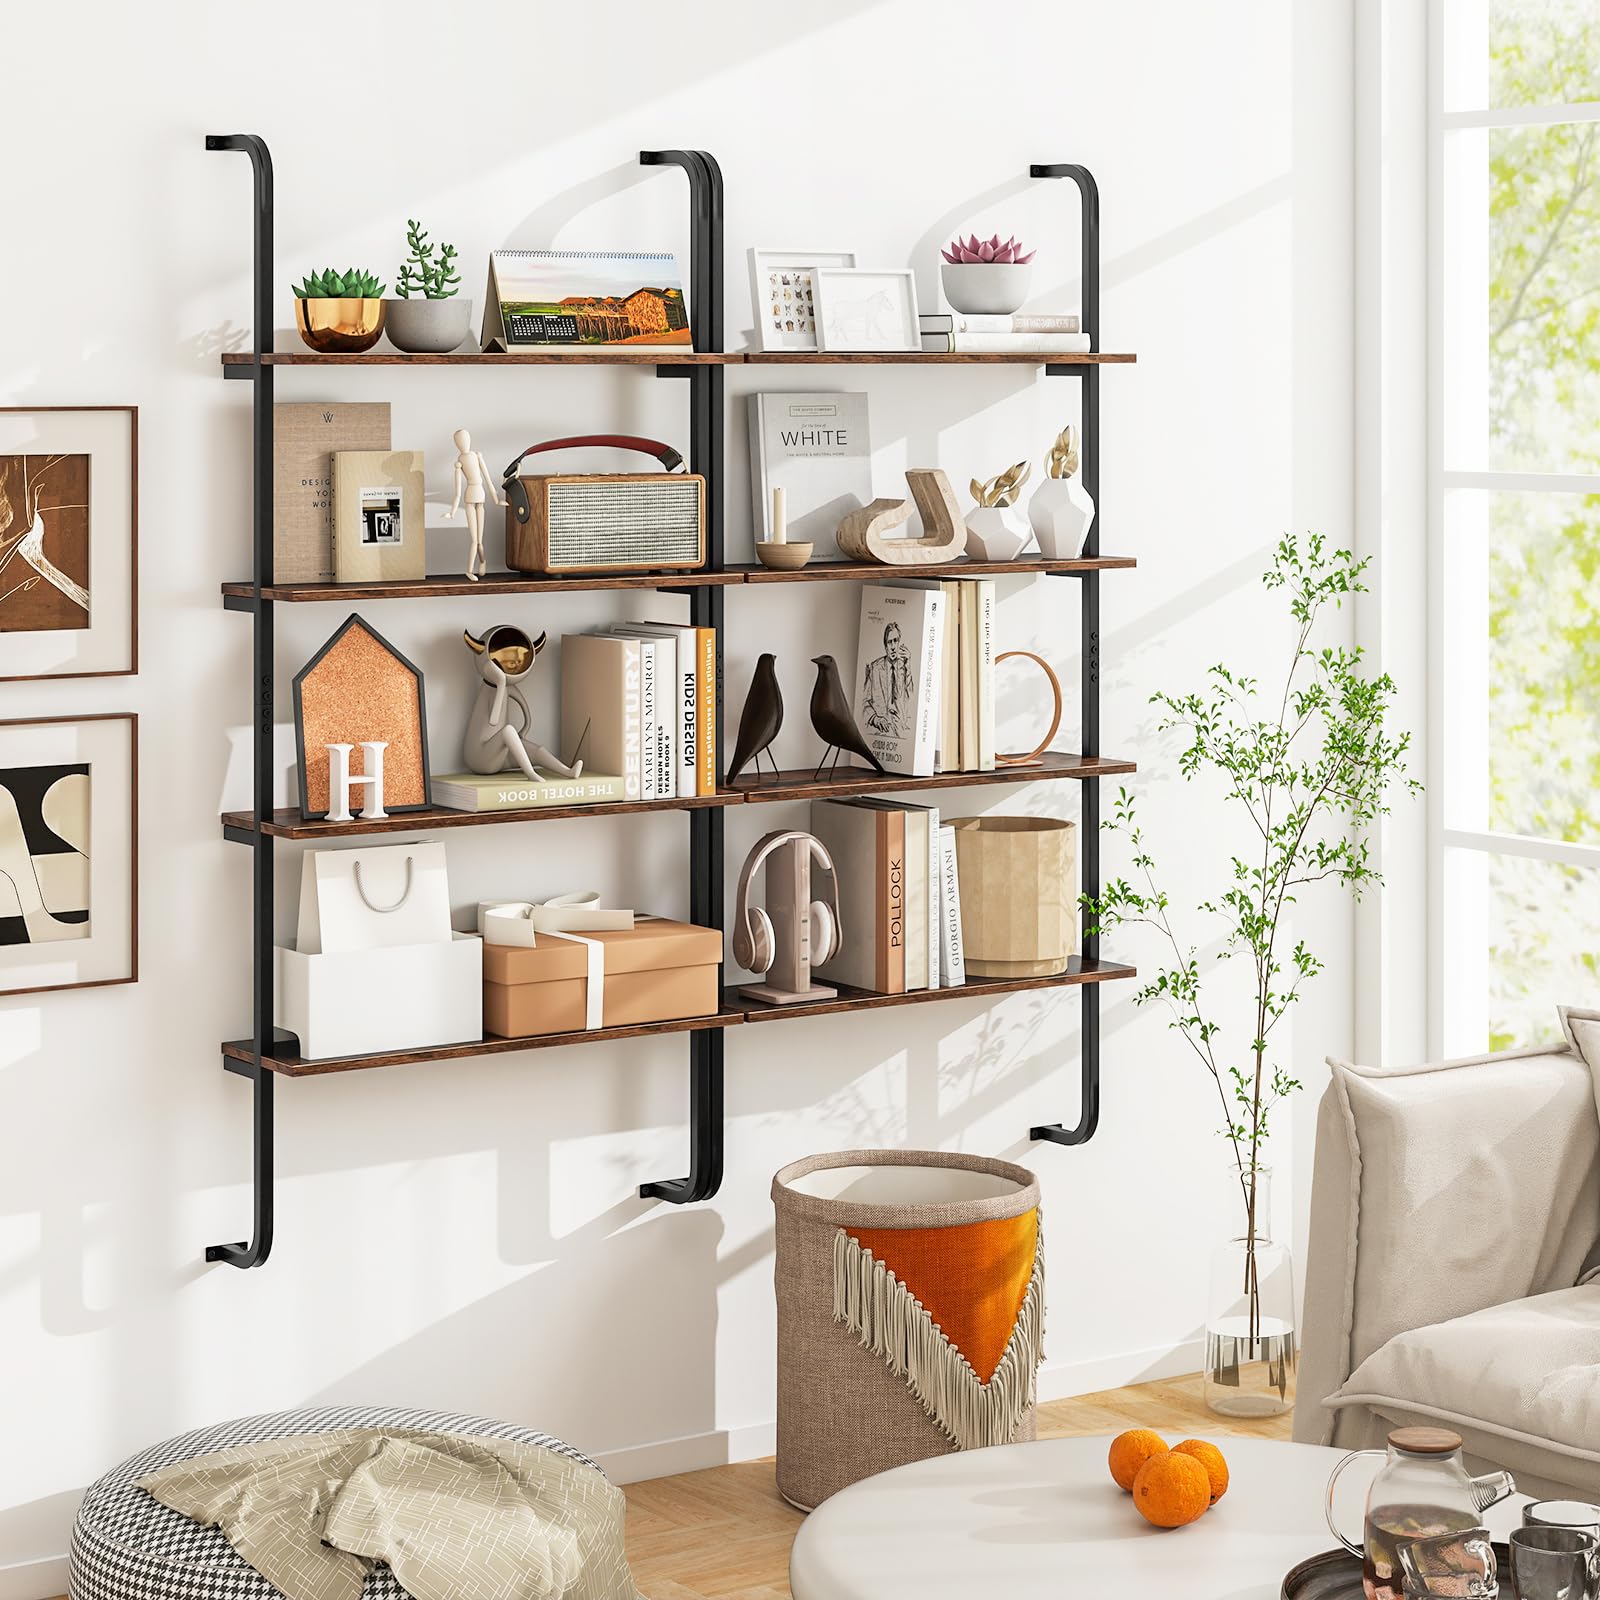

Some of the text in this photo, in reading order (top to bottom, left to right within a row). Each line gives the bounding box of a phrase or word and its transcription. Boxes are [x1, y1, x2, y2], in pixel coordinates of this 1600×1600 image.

[780, 430, 848, 447] WHITE
[624, 647, 640, 797] CENTURY
[645, 649, 653, 791] MARILYN MONROE
[324, 741, 389, 821] H
[498, 783, 615, 803] THE HOTEL BOOK
[890, 858, 902, 947] POLLOCK
[945, 849, 960, 967] GIORGIO ARMANI
